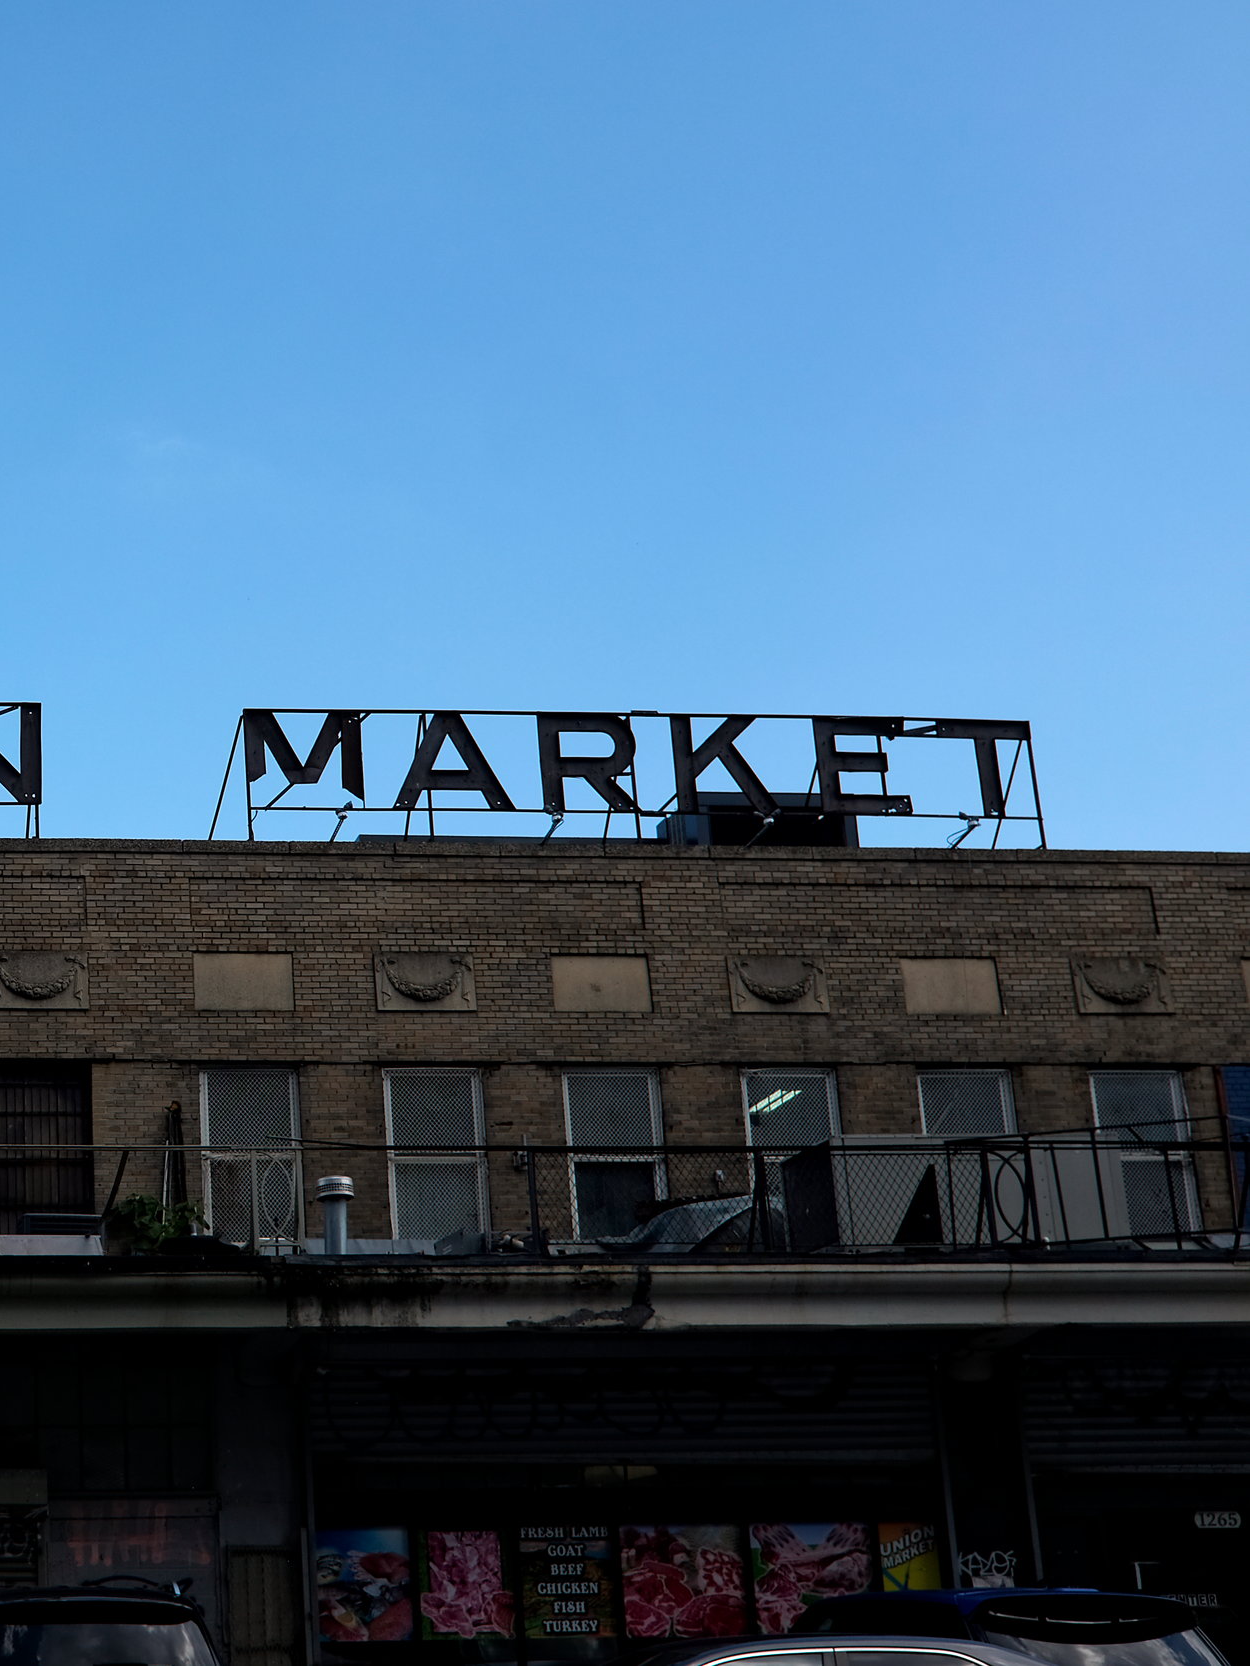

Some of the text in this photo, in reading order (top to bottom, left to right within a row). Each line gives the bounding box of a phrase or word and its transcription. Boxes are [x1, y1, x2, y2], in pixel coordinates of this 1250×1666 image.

[243, 708, 1031, 818] MARKET
[1199, 1512, 1238, 1527] 1265
[519, 1526, 609, 1539] FRESH LAMB
[879, 1523, 935, 1557] UNION
[547, 1544, 584, 1557] GOAT
[881, 1539, 937, 1569] MARKET
[550, 1563, 584, 1576] BEEF
[537, 1582, 599, 1595] CHICKEN
[553, 1601, 586, 1614] FISH
[543, 1619, 598, 1633] TURKEY
